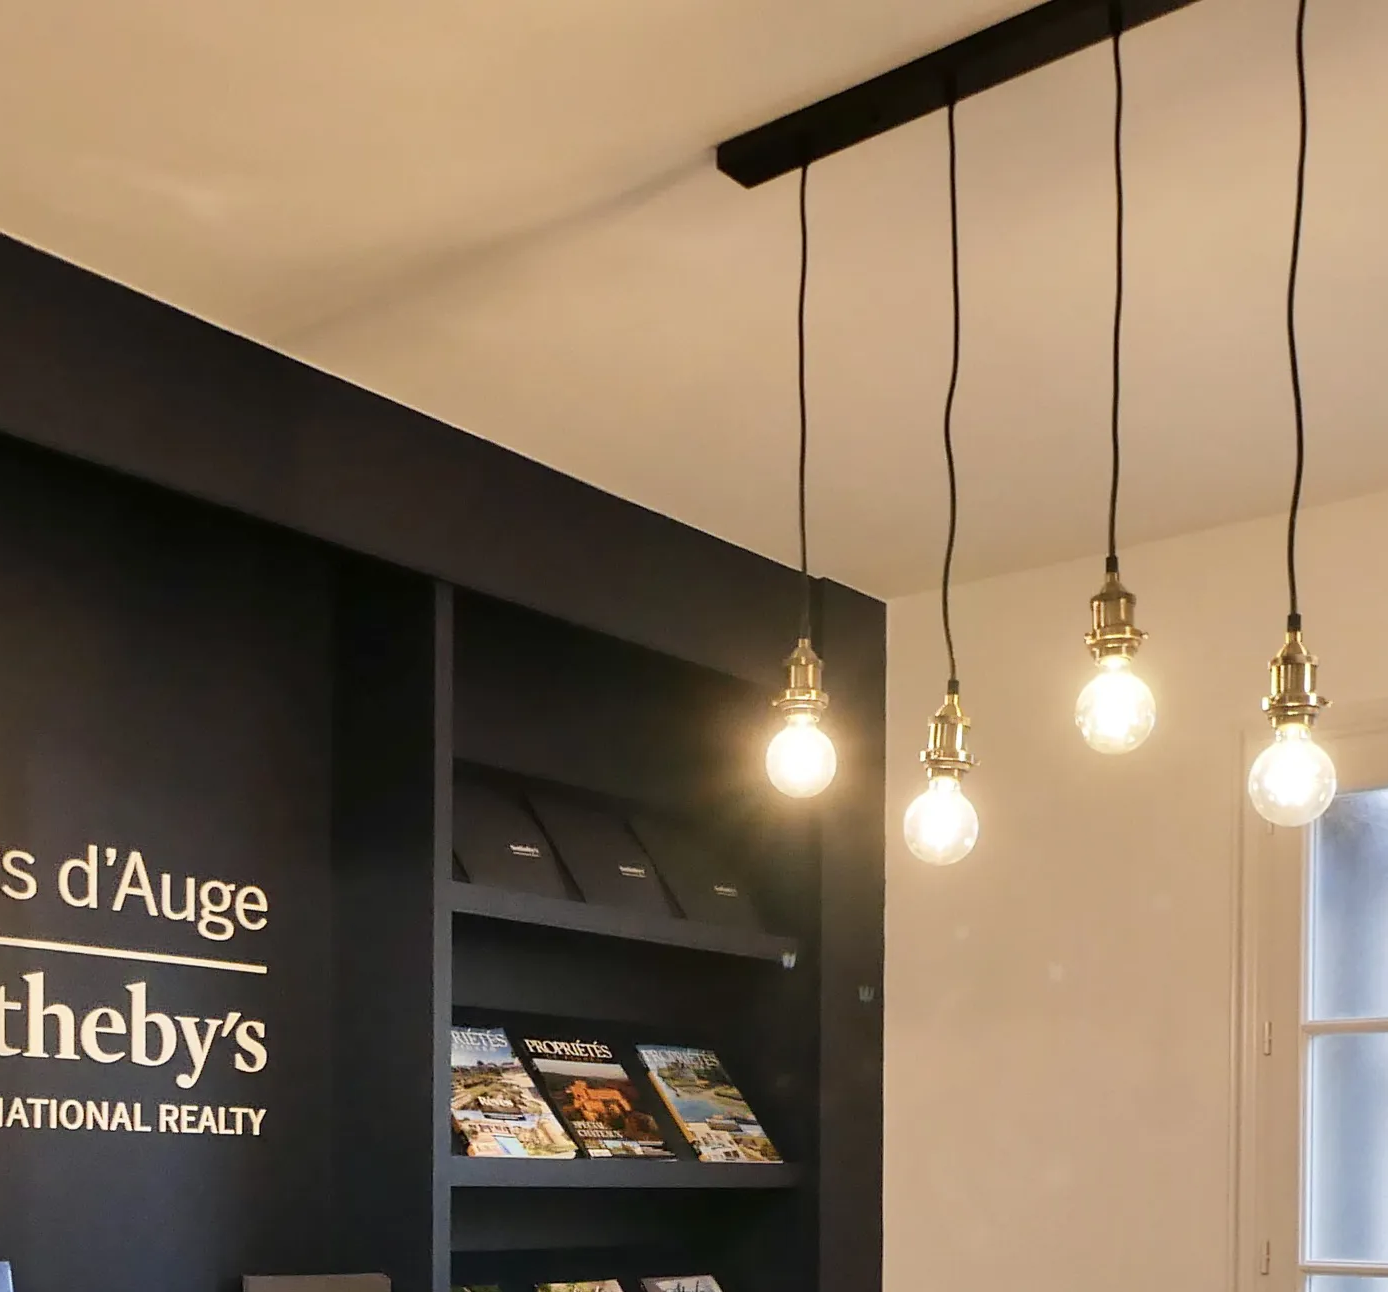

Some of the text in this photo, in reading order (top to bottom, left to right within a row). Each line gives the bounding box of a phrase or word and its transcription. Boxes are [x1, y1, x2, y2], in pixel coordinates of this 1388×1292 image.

[58, 845, 268, 941] d'Auge
[524, 1039, 612, 1058] PROPRIÉTÉS
[158, 1105, 268, 1136] REALTY
